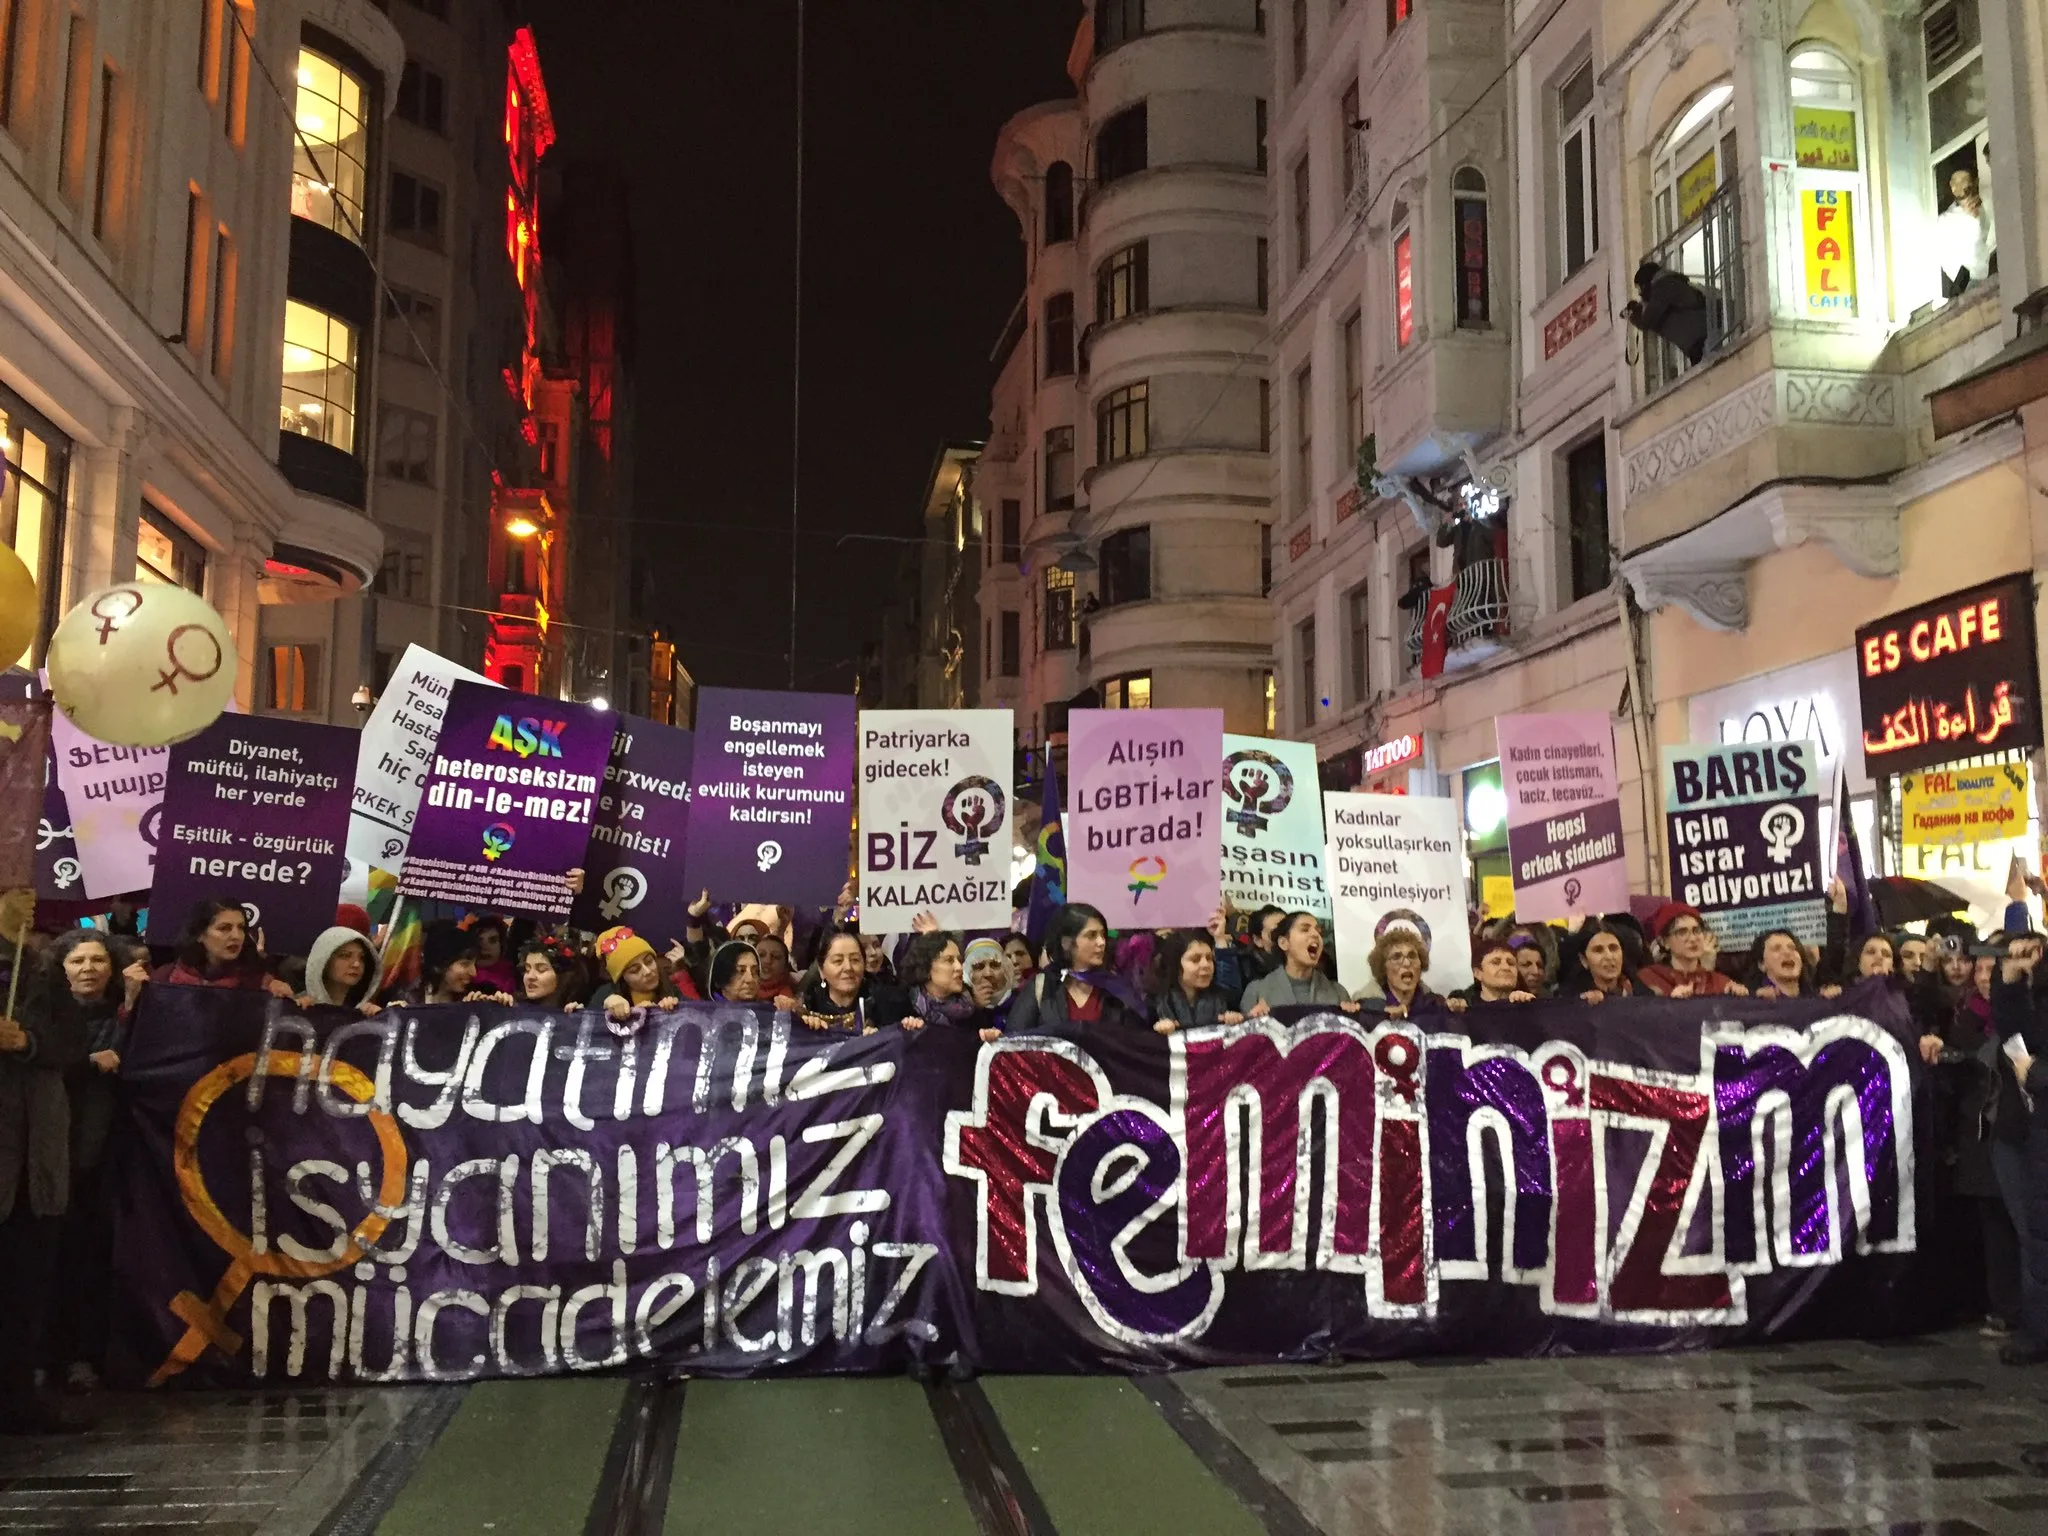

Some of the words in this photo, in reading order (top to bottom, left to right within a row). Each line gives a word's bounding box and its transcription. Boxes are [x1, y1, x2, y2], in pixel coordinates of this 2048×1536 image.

[1863, 629, 1901, 678] ES
[1908, 598, 2003, 663] CAFE
[411, 670, 451, 701] Mün
[485, 713, 568, 759] AŞK
[730, 715, 823, 737] Boşanmayı
[865, 729, 970, 752] Patriyarka
[229, 739, 304, 765] Diyanet,
[724, 740, 825, 758] engellemek
[1107, 738, 1184, 768] Alışın
[1364, 734, 1413, 772] TATTOO
[1509, 746, 1541, 763] Kadın
[1544, 742, 1605, 763] cinayetleri,
[187, 759, 249, 781] müftü,
[255, 765, 338, 792] ilahiyatçı
[378, 752, 412, 784] hiç
[434, 755, 597, 794] heteroseksizm
[743, 761, 804, 781] isteyen
[865, 759, 949, 783] gidecek!
[1516, 767, 1549, 785] çocuk
[1552, 764, 1603, 782] istismarı,
[1672, 744, 1807, 804] BARIŞ
[1923, 772, 1955, 795] FAL
[215, 783, 248, 801] her
[252, 790, 306, 808] yerde
[352, 785, 402, 819] RKEK
[427, 781, 592, 824] din-le-mez!
[698, 782, 751, 799] evlilik
[756, 784, 845, 803] kurumunu
[1078, 774, 1214, 814] LGBTİ+lar
[1519, 788, 1550, 804] taciz,
[620, 800, 645, 821] ya
[729, 805, 812, 825] kaldırsın!
[1335, 809, 1402, 826] Kadınlar
[173, 824, 233, 845] Eşitlik
[253, 832, 335, 855] özgürlük
[1087, 812, 1203, 852] burada!
[1546, 812, 1586, 844] Hepsi
[1674, 813, 1729, 848] için
[867, 821, 938, 872] BİZ
[1336, 835, 1451, 855] yoksullaşırken
[1521, 851, 1563, 881] erkek
[1566, 832, 1617, 870] şiddeti!
[1679, 844, 1745, 877] ısrar
[189, 856, 312, 885] nerede?
[1338, 857, 1399, 878] Diyanet
[867, 876, 1006, 907] KALACAĞIZ!
[1220, 889, 1328, 909] cadelemiz!
[1340, 882, 1451, 903] zenginleşiyor!
[1684, 861, 1814, 908] ediyoruz!
[943, 1011, 1917, 1345] feminizm
[250, 1221, 940, 1384] mücadelemiz
